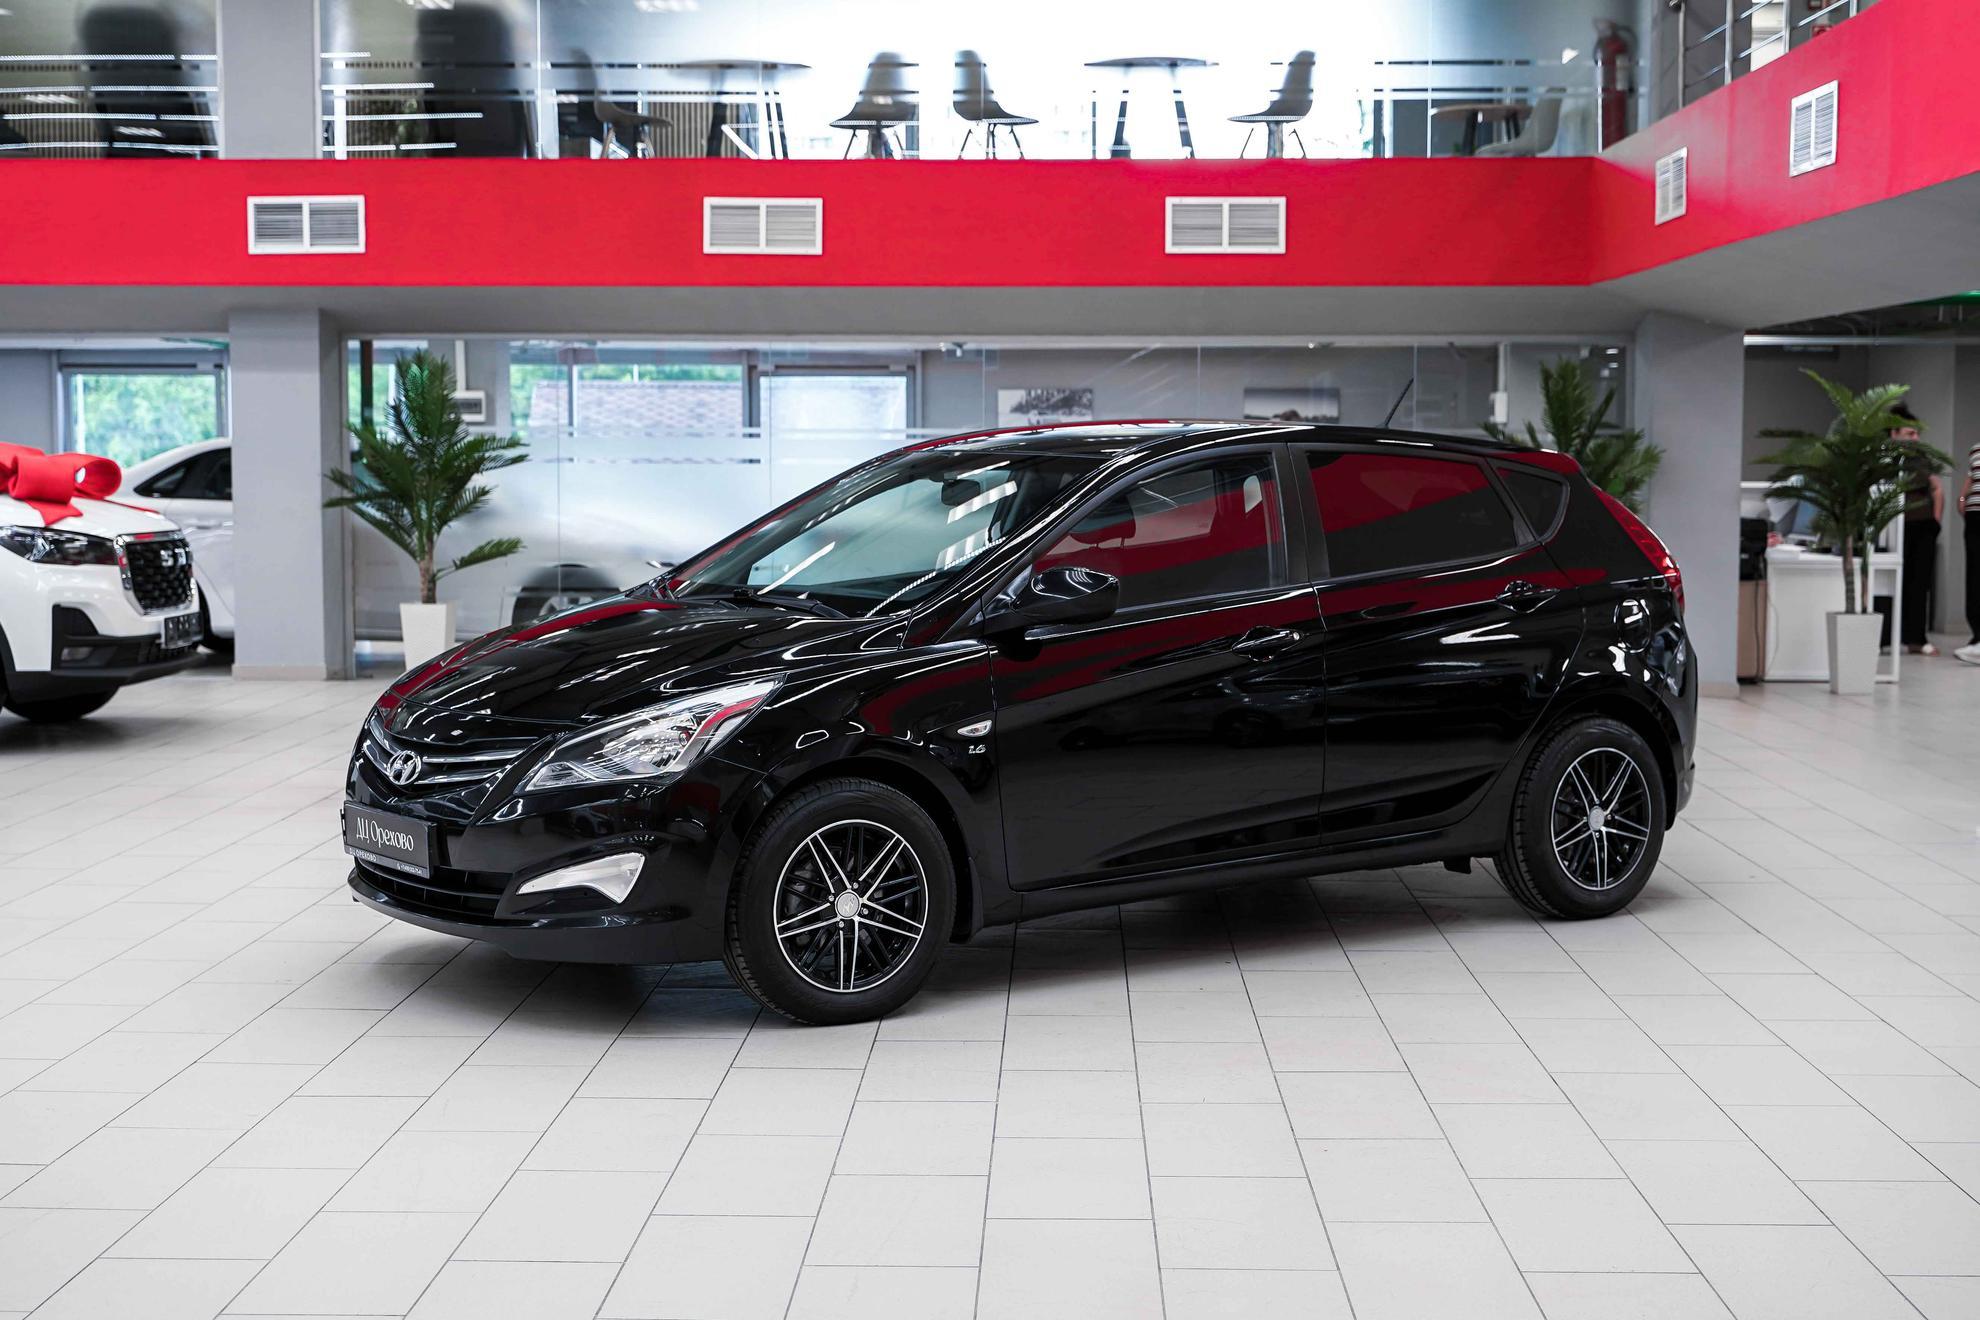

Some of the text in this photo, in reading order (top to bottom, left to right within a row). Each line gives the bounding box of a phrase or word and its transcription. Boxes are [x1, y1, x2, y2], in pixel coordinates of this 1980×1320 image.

[968, 744, 986, 754] 1.6
[356, 817, 414, 851] ДЦ Орехово
